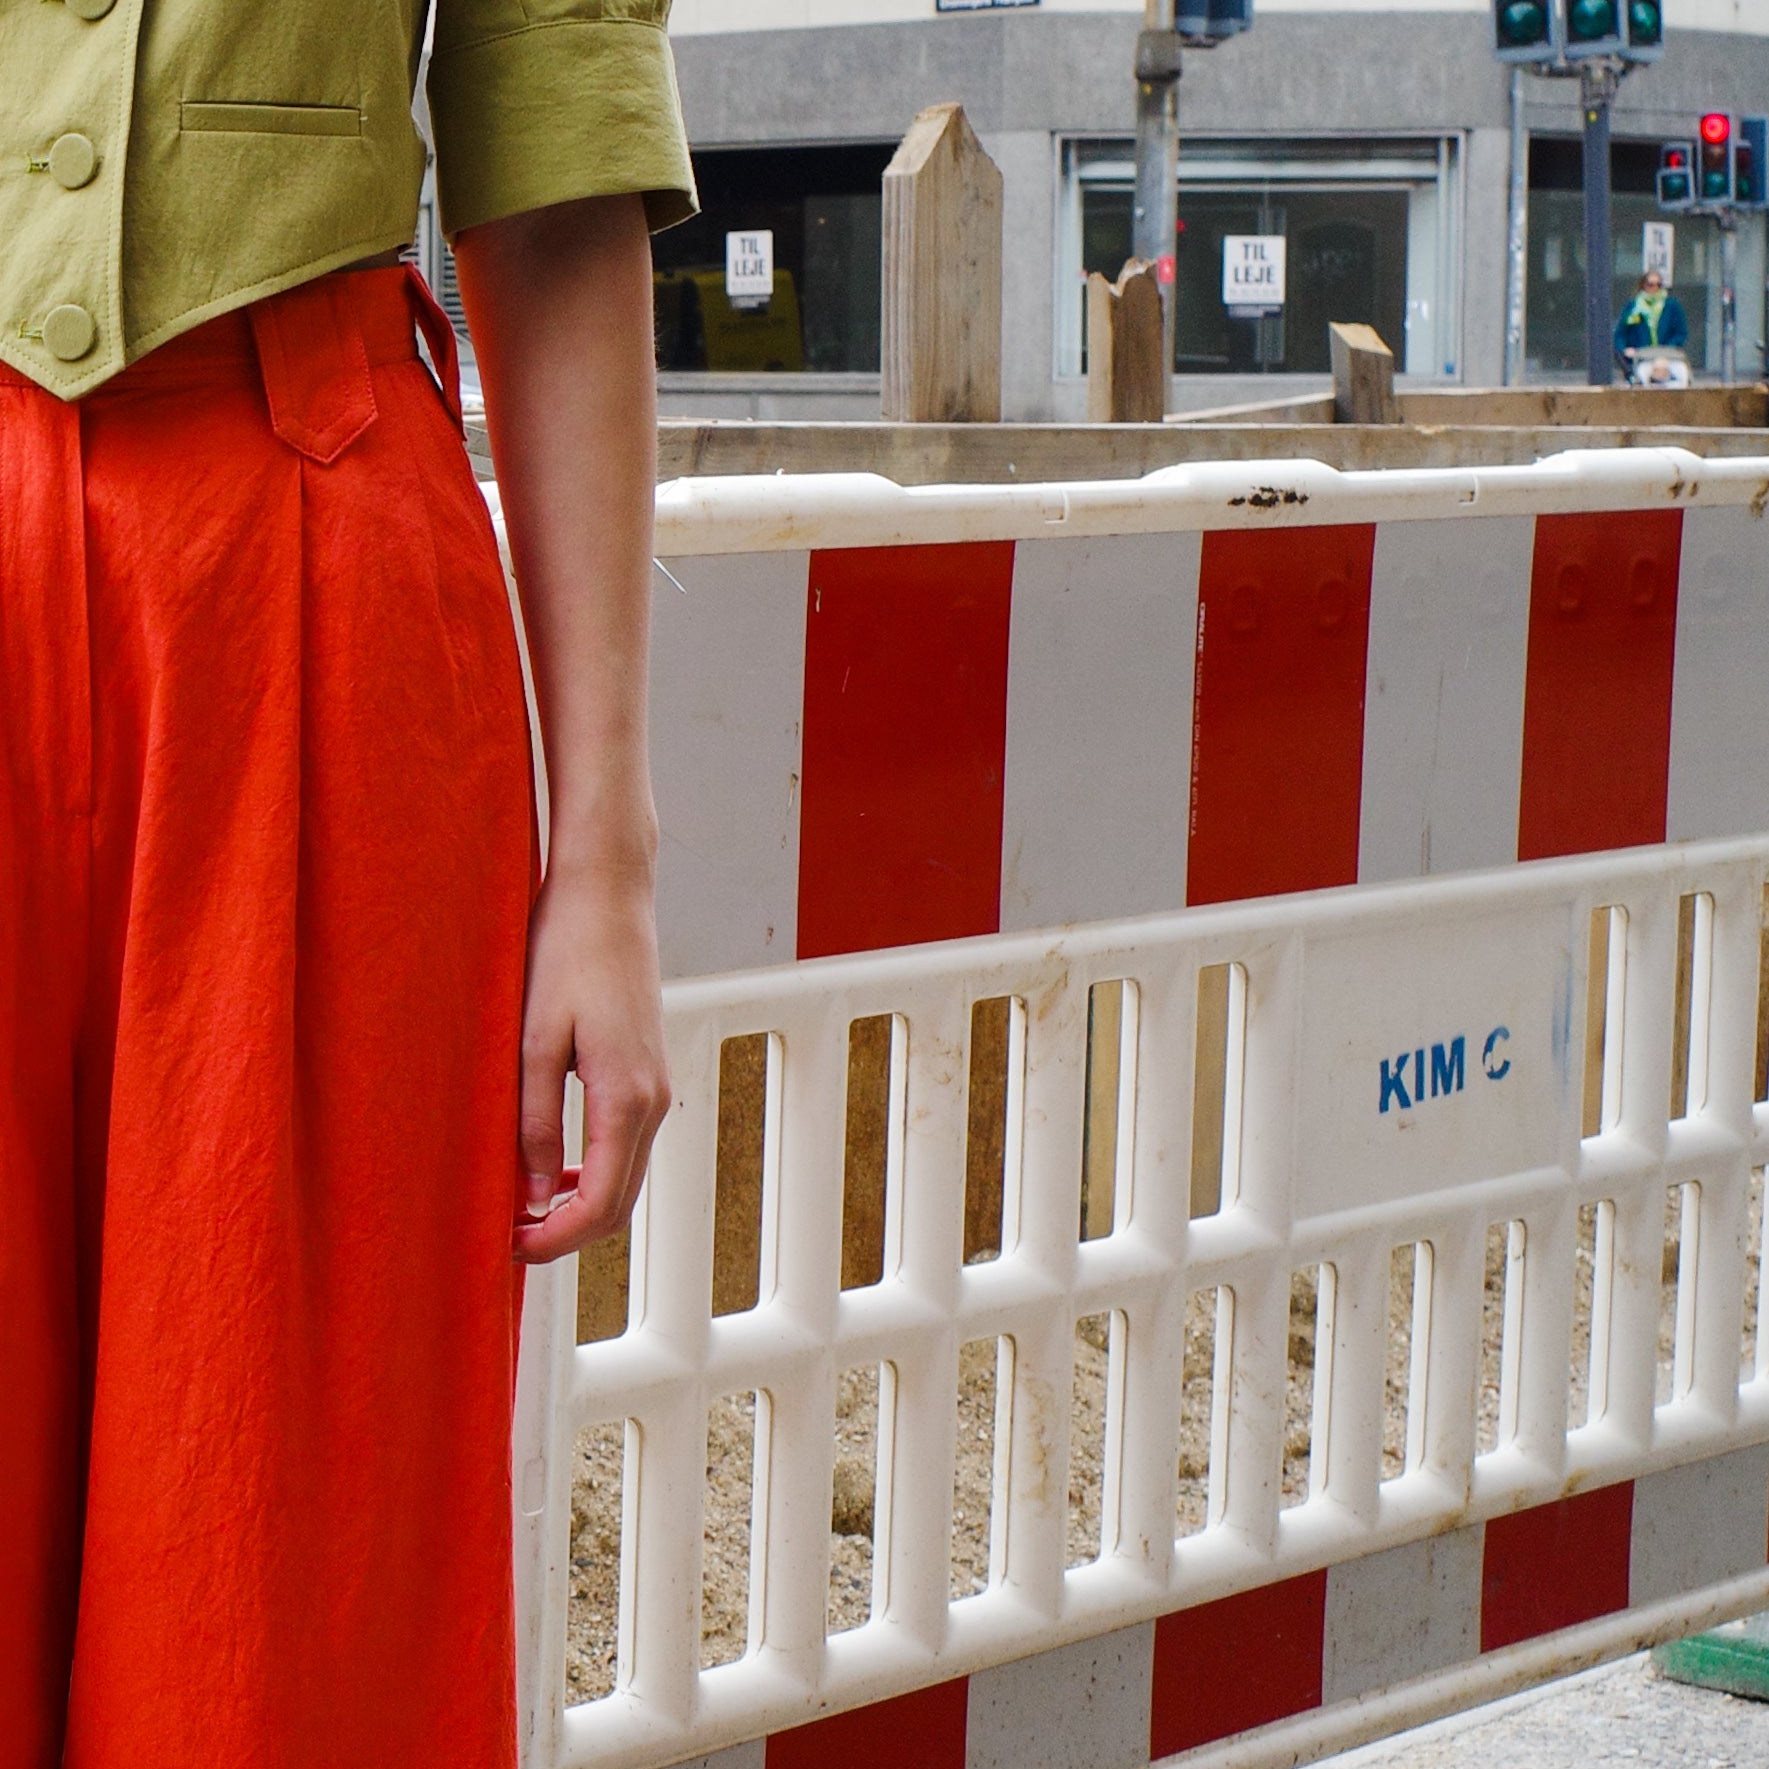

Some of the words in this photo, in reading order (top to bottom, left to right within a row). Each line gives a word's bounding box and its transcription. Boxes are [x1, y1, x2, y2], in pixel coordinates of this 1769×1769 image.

[741, 237, 760, 253] TIL
[1243, 243, 1266, 260] TIL
[735, 259, 765, 276] LEJE
[1234, 266, 1273, 283] LEJE
[1379, 1035, 1465, 1114] KIM
